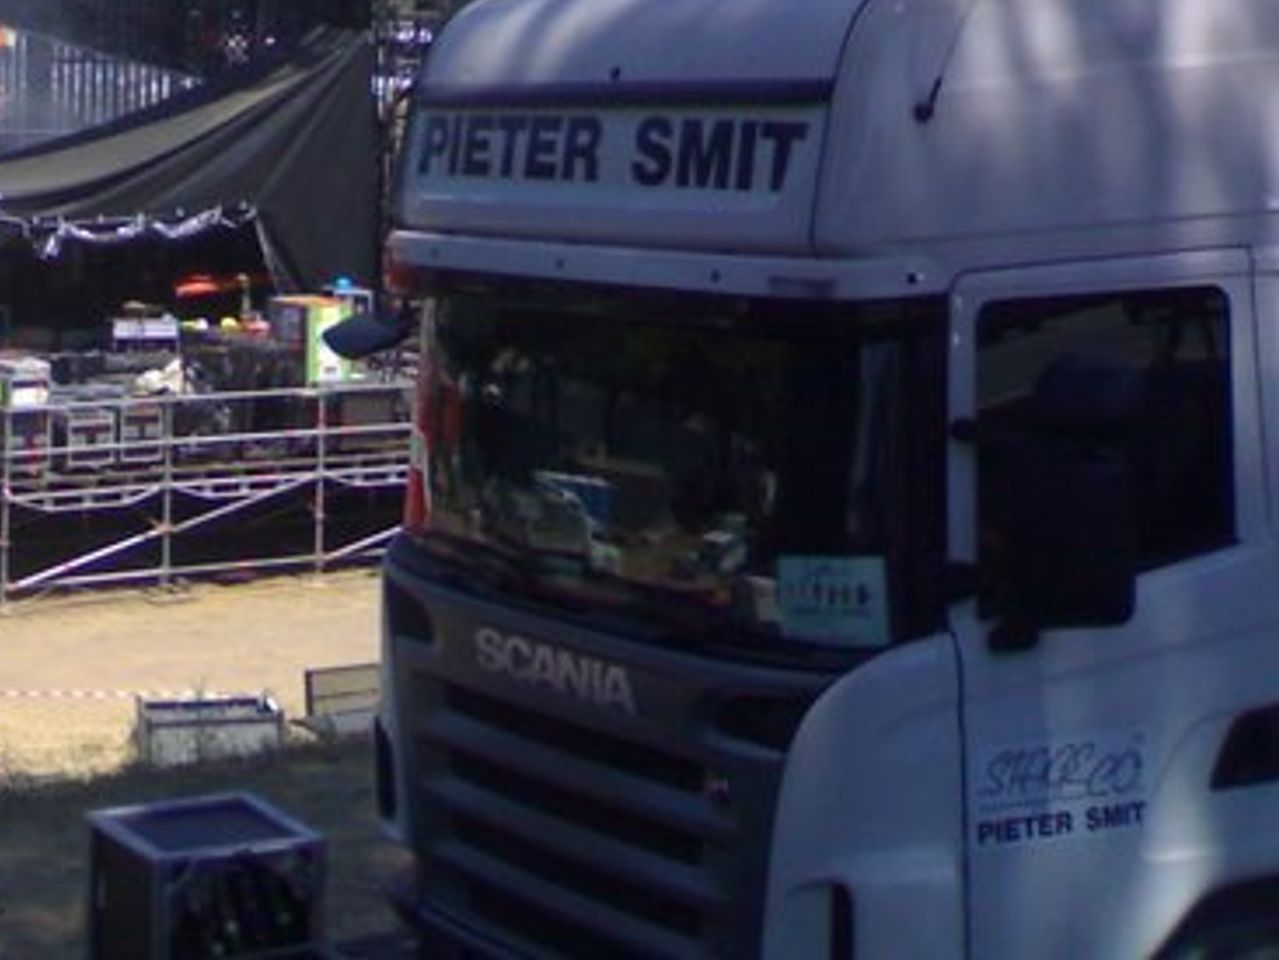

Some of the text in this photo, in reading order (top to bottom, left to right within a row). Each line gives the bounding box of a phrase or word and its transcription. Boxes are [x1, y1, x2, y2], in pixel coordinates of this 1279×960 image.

[417, 114, 808, 193] PIETER SMIT
[474, 626, 638, 718] SCANIA
[977, 799, 1148, 846] PIETER SMIT
